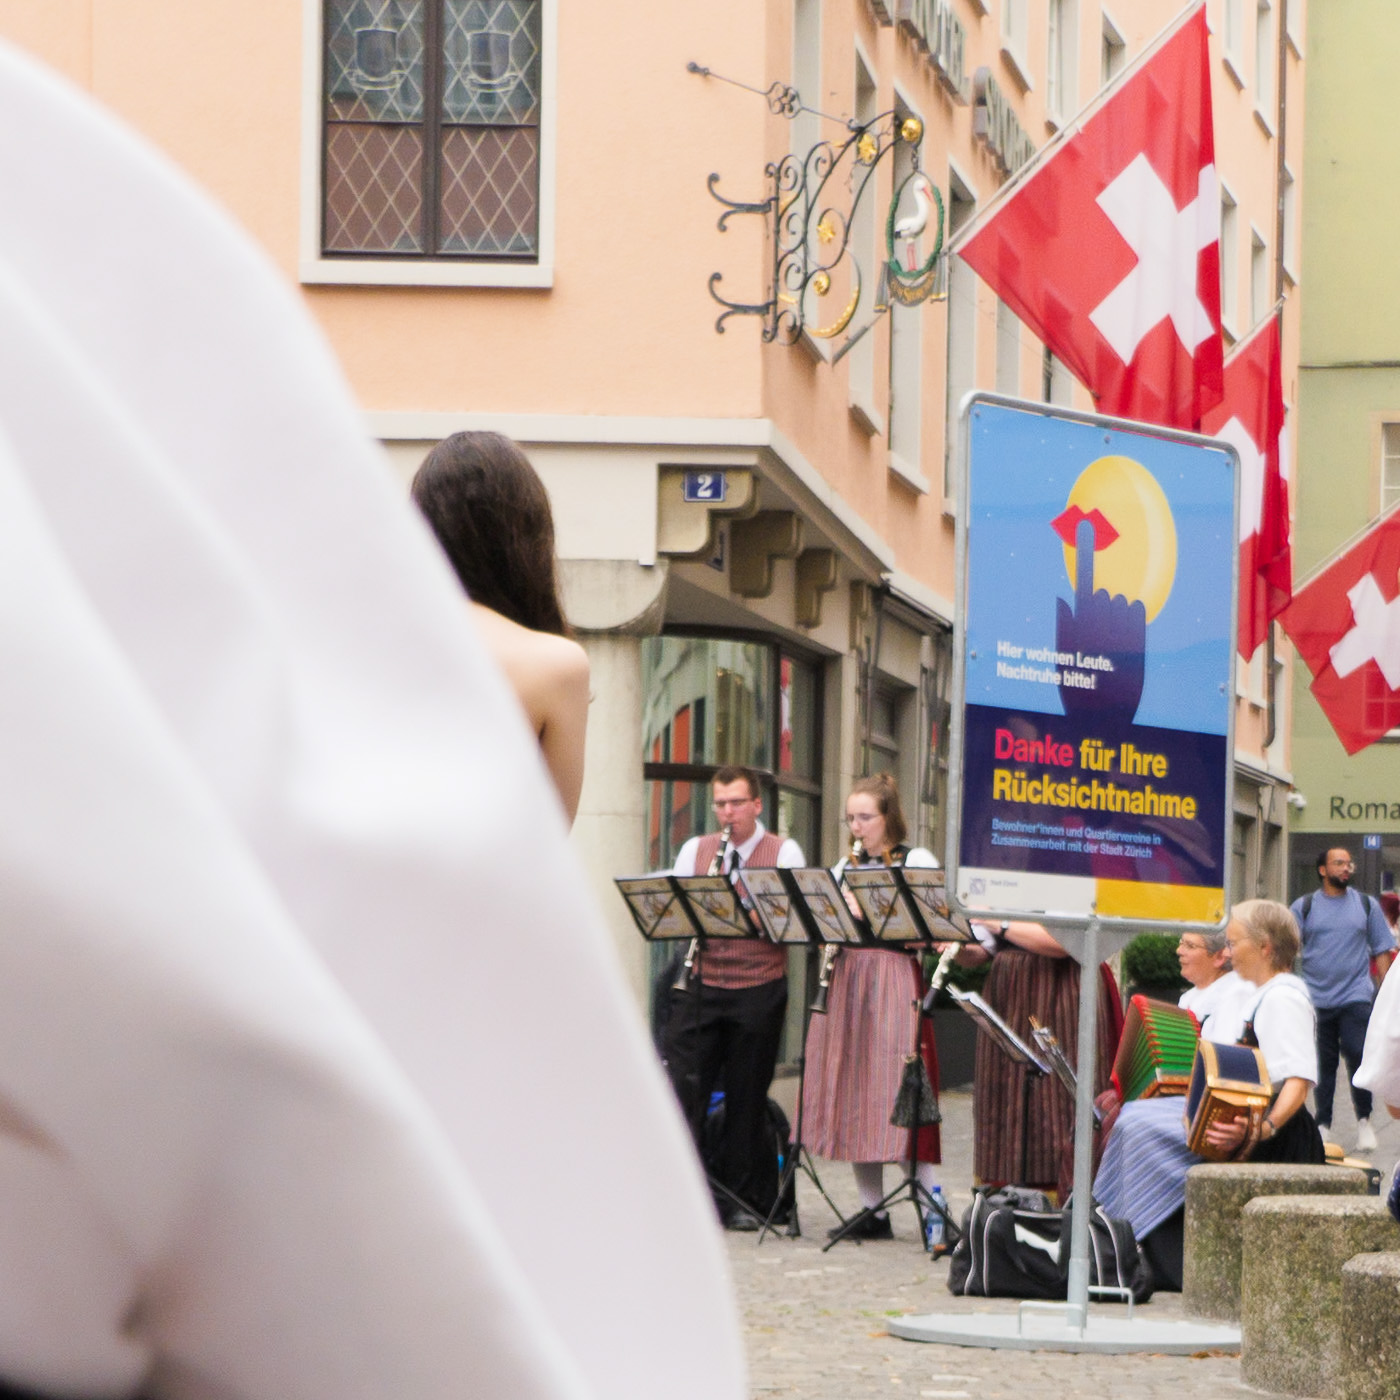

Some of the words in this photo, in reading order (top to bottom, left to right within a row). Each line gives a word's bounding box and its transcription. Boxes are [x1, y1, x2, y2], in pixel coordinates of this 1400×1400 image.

[697, 474, 713, 498] 2
[997, 641, 1023, 659] Hier
[1026, 647, 1075, 667] wohnen
[1076, 651, 1114, 672] Leute.
[996, 661, 1062, 686] Nachtruhe
[1063, 670, 1096, 690] bitte!
[994, 728, 1074, 768] Danke
[1079, 738, 1115, 772] für
[1120, 743, 1168, 779] Ihre
[993, 768, 1196, 820] Rücksichtnahme
[991, 833, 1066, 851] Zusammenarbeit
[1067, 842, 1082, 852] mit
[1083, 842, 1098, 854] der
[1099, 842, 1124, 857] Stadt
[1124, 845, 1152, 859] Zürich
[1066, 827, 1083, 838] und
[1084, 827, 1152, 844] Quartiervereine
[1152, 833, 1161, 845] in
